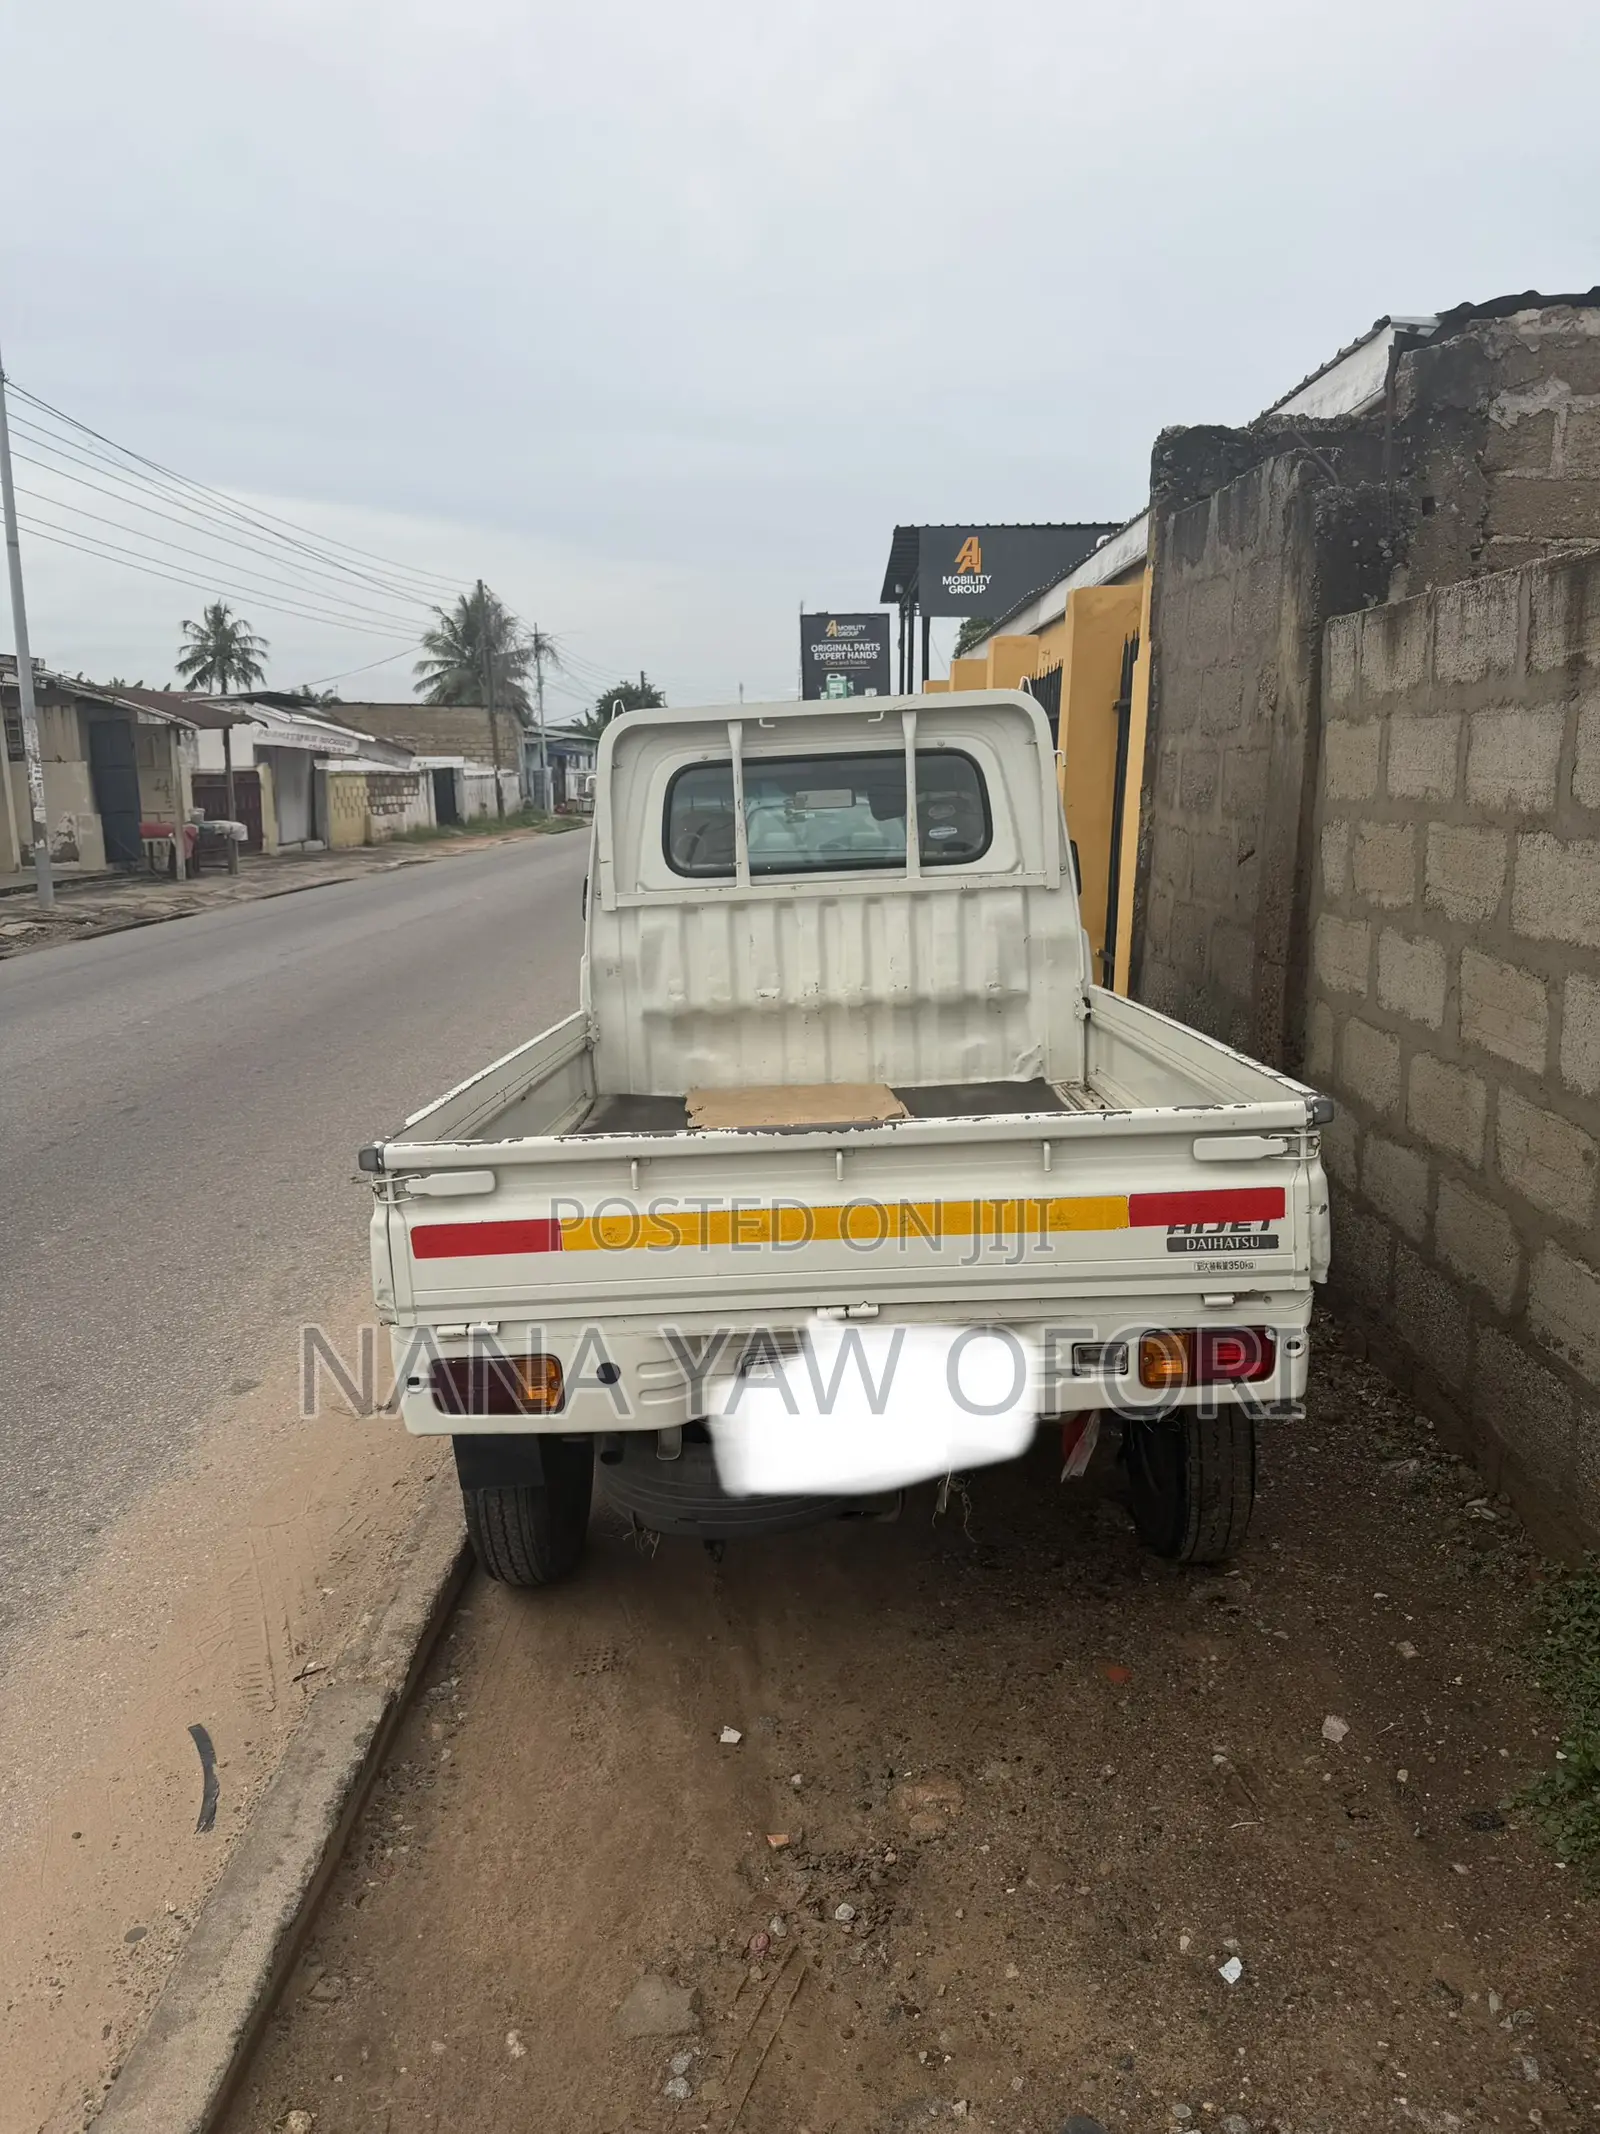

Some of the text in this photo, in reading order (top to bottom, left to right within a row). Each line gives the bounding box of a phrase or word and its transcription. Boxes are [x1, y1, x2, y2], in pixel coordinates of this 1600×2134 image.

[942, 575, 992, 585] MOBILITY
[948, 585, 986, 594] GROUP
[811, 643, 881, 652] ORIGINAL PARTS
[814, 651, 878, 660] EXPERT HANDS
[1186, 1236, 1260, 1250] DAIHATSU
